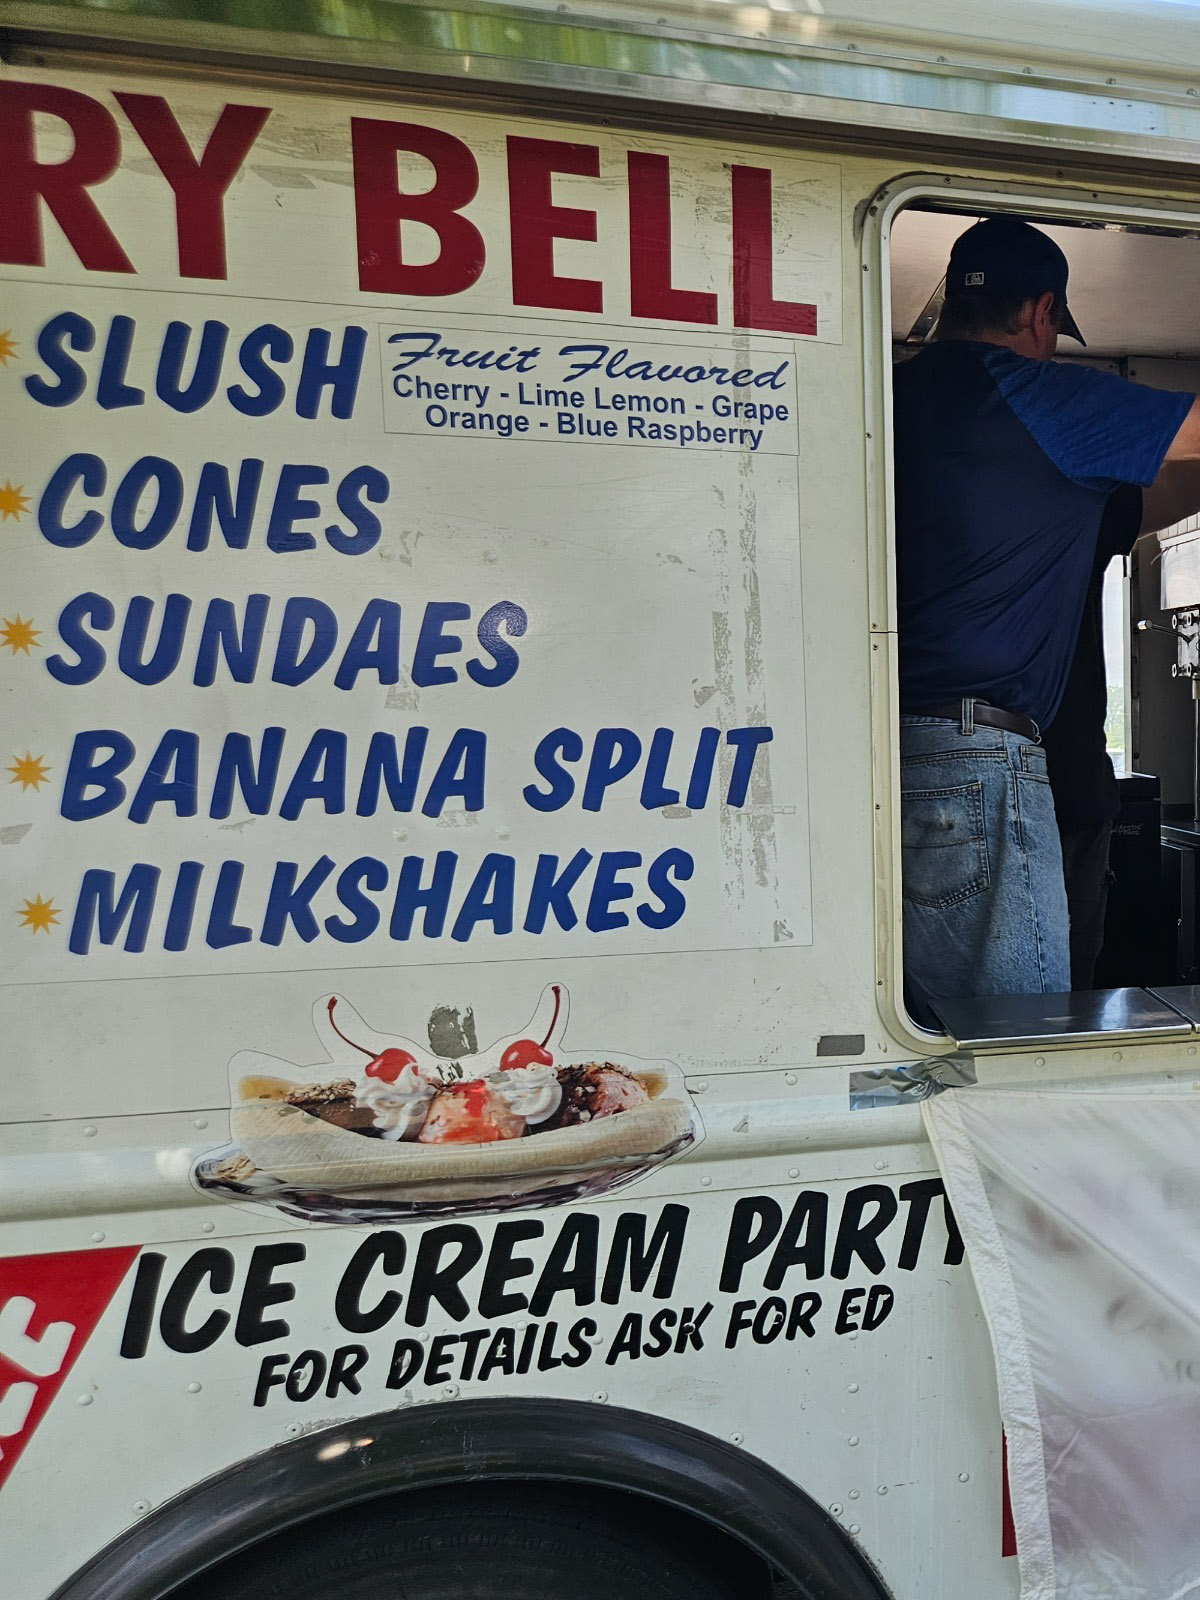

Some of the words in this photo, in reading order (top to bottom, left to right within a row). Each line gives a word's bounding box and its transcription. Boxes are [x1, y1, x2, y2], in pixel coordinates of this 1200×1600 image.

[351, 116, 818, 337] BELL
[24, 311, 367, 420] SLUSH
[388, 332, 538, 373] Fruit
[558, 344, 788, 390] Flavored
[393, 374, 490, 407] Cherry
[518, 382, 585, 408] Lime
[595, 386, 686, 415] Lemon
[712, 394, 790, 422] Grape
[426, 404, 529, 436] Orange
[557, 412, 618, 437] Blue
[628, 415, 763, 449] Raspberry
[38, 453, 390, 555] CONES
[45, 592, 528, 690] SUNDAES
[60, 726, 486, 824] BANANA
[522, 726, 774, 813] SPLIT
[69, 847, 695, 956] MILKSHAKES
[119, 1242, 306, 1359] ICE
[336, 1204, 690, 1334] CREAM
[254, 1343, 366, 1407] FOR
[388, 1317, 614, 1389] DETAILS
[606, 1303, 708, 1365] ASK
[725, 1290, 820, 1351] FOR
[834, 1284, 893, 1336] ED
